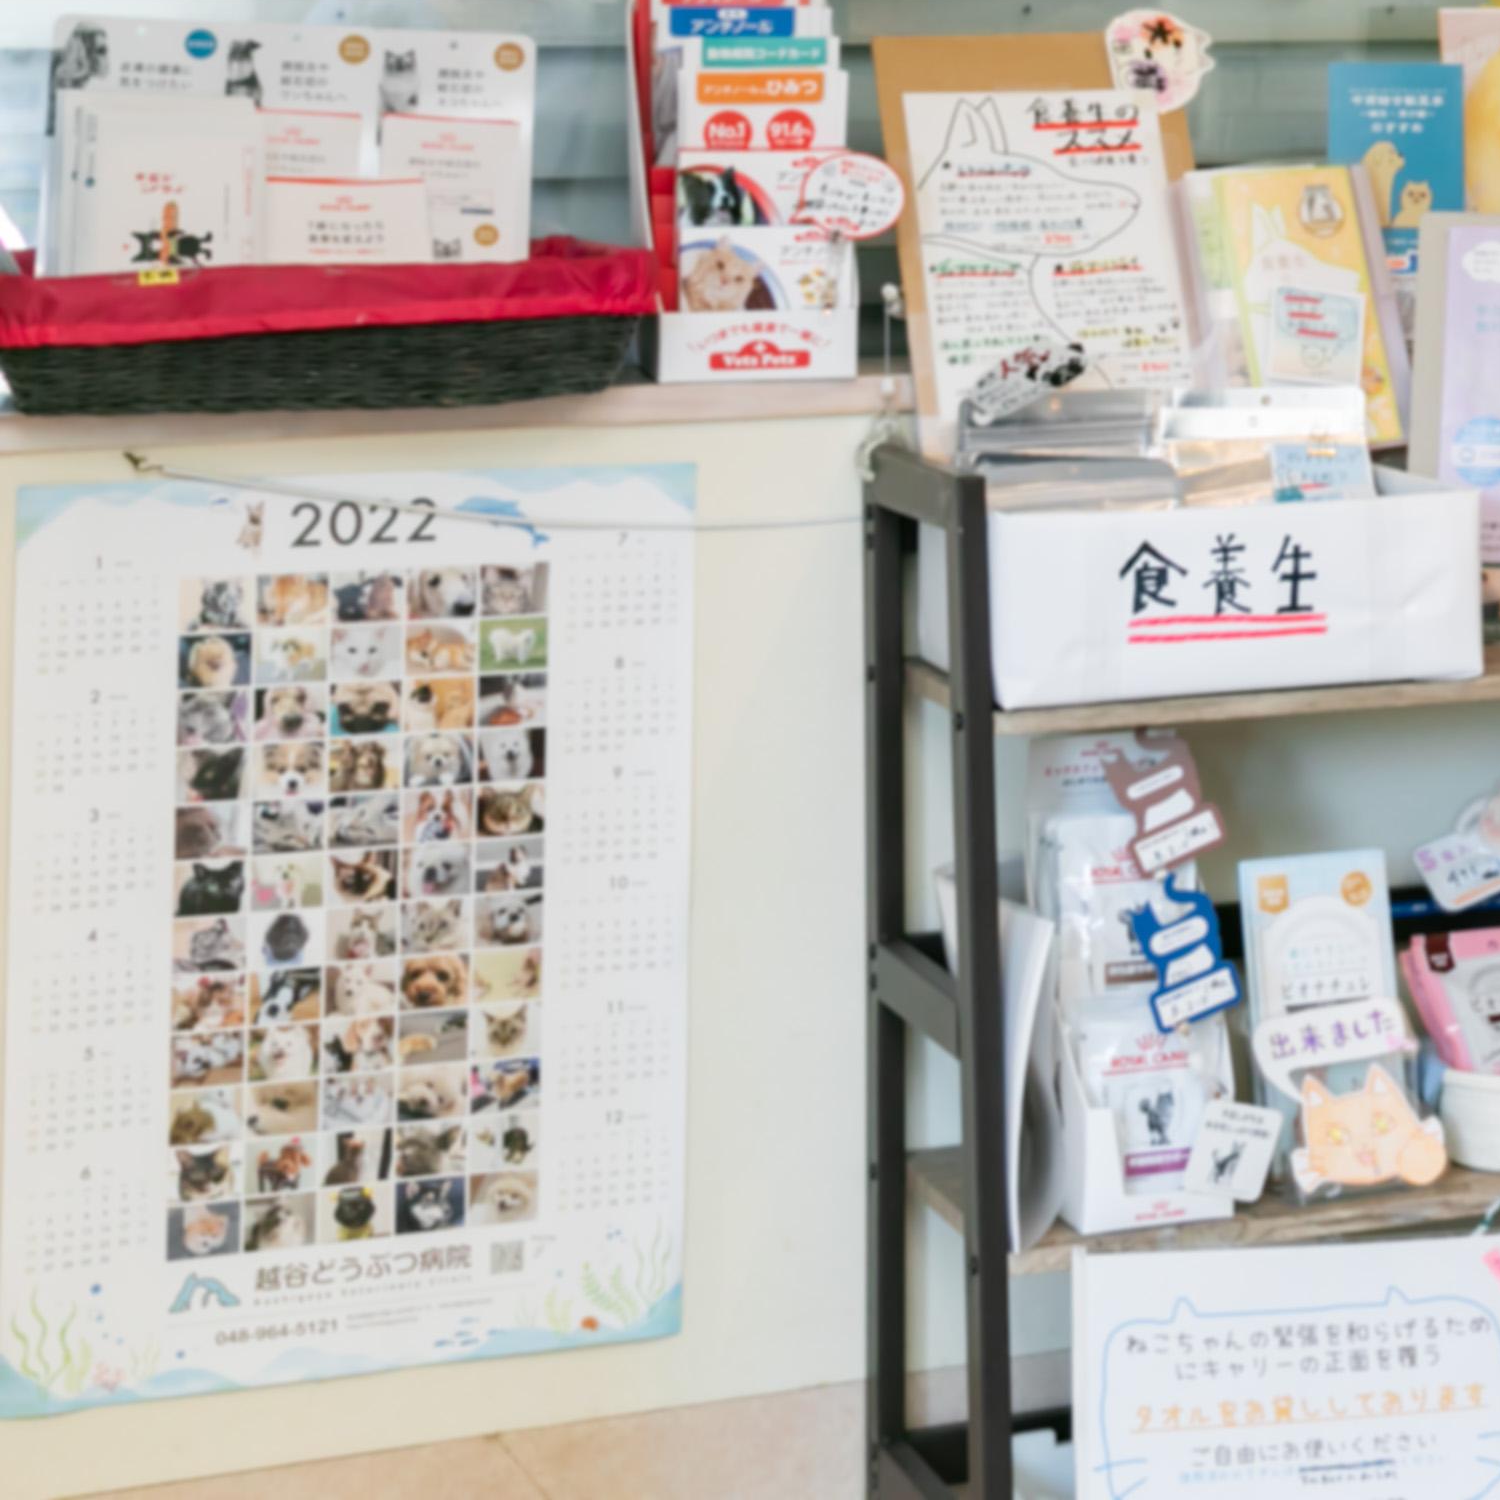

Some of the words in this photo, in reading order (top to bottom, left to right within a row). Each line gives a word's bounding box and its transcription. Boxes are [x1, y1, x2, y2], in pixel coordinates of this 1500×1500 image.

[290, 498, 438, 548] 2022
[1119, 533, 1318, 616] 食養生
[609, 876, 628, 891] 10
[1269, 1008, 1394, 1060] 出来ました
[604, 1109, 625, 1125] 12
[254, 1243, 473, 1292] 越谷どうぶつ病院
